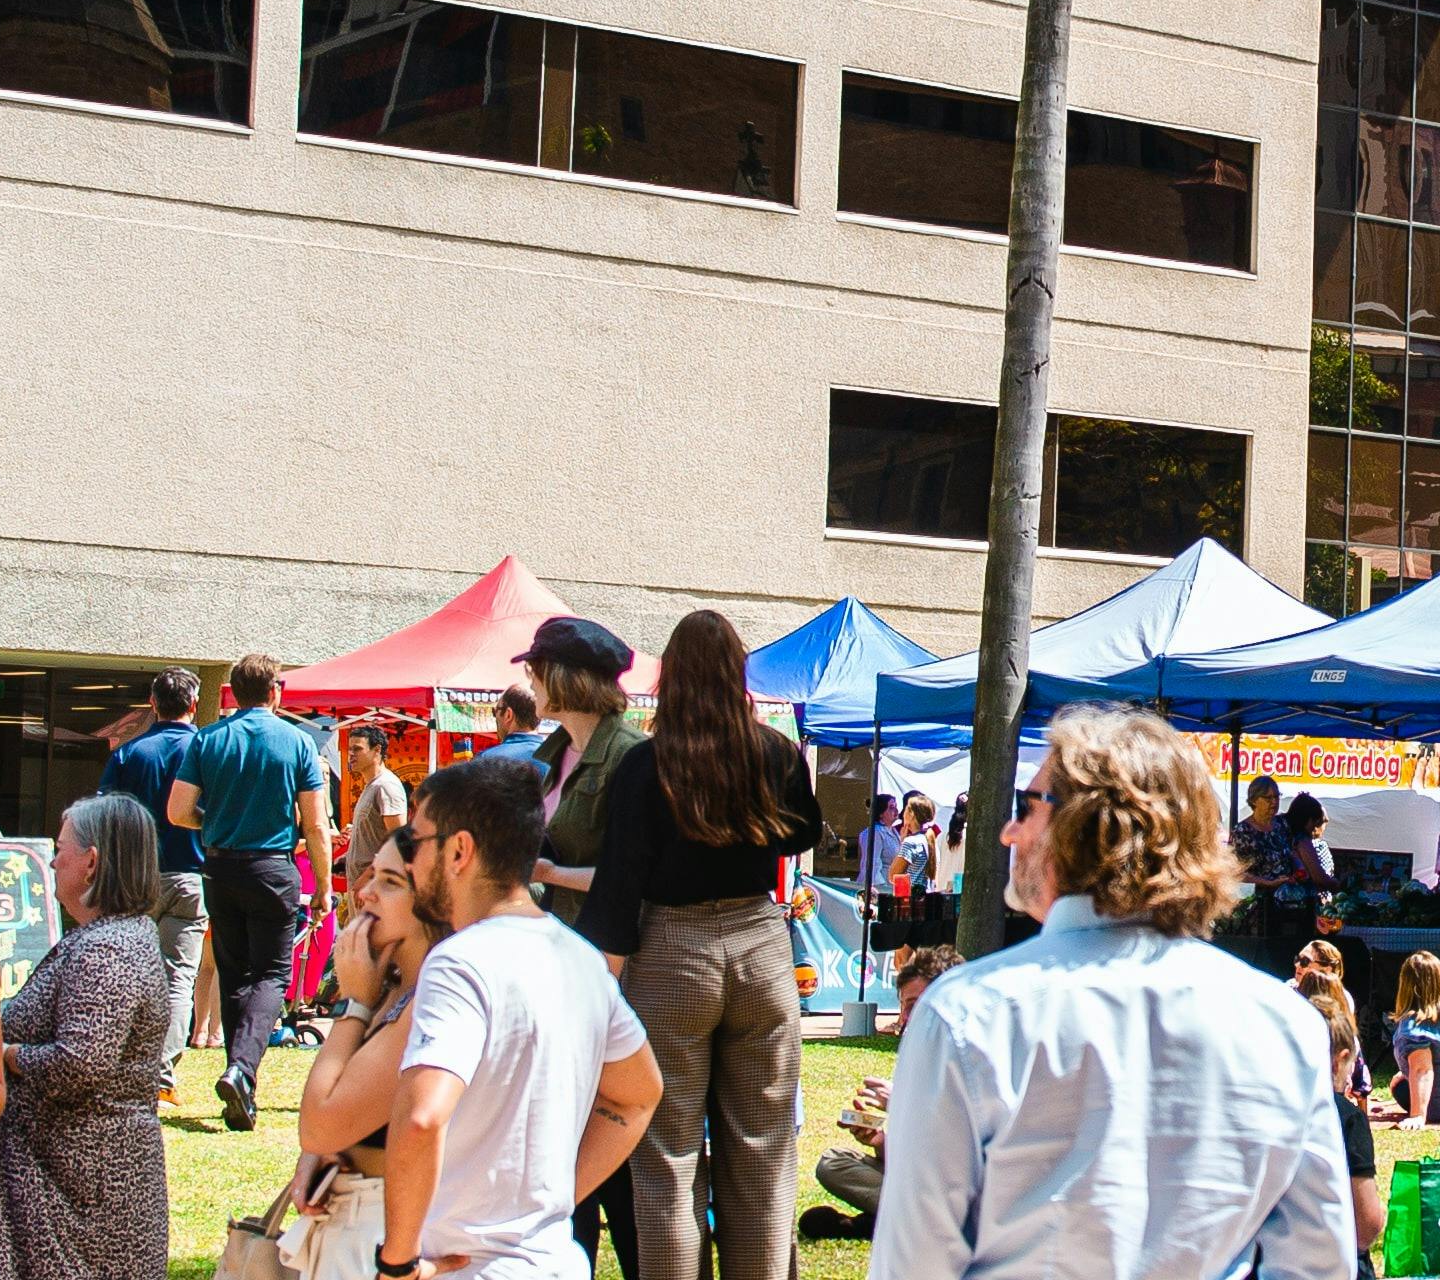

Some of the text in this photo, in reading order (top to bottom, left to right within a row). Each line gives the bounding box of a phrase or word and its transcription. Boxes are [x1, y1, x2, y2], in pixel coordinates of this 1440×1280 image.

[1312, 671, 1346, 681] KINGS
[1220, 742, 1401, 783] Korean Corndog
